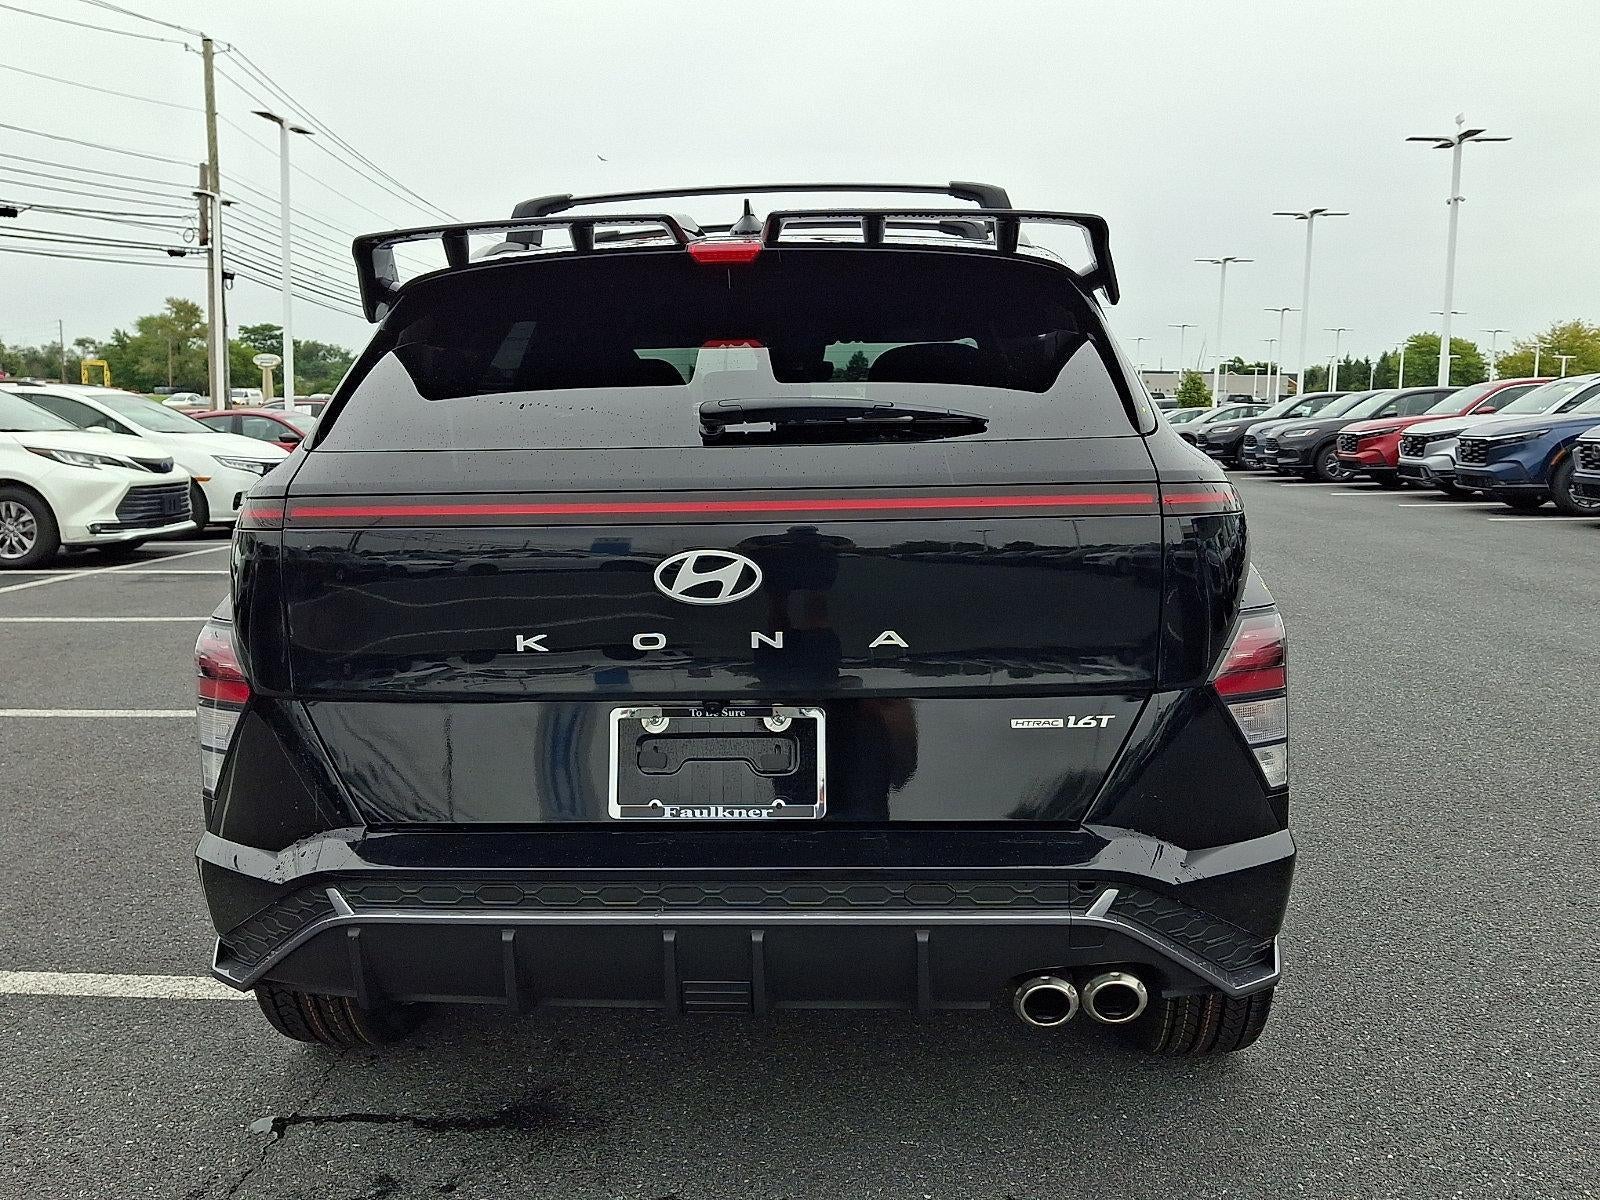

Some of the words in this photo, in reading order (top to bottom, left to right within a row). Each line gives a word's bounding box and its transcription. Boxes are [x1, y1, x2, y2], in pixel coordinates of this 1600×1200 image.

[515, 630, 909, 653] KONA
[688, 708, 703, 717] To
[721, 708, 746, 717] Sure
[1013, 719, 1060, 727] HTRAC
[662, 806, 774, 818] Faulkner
